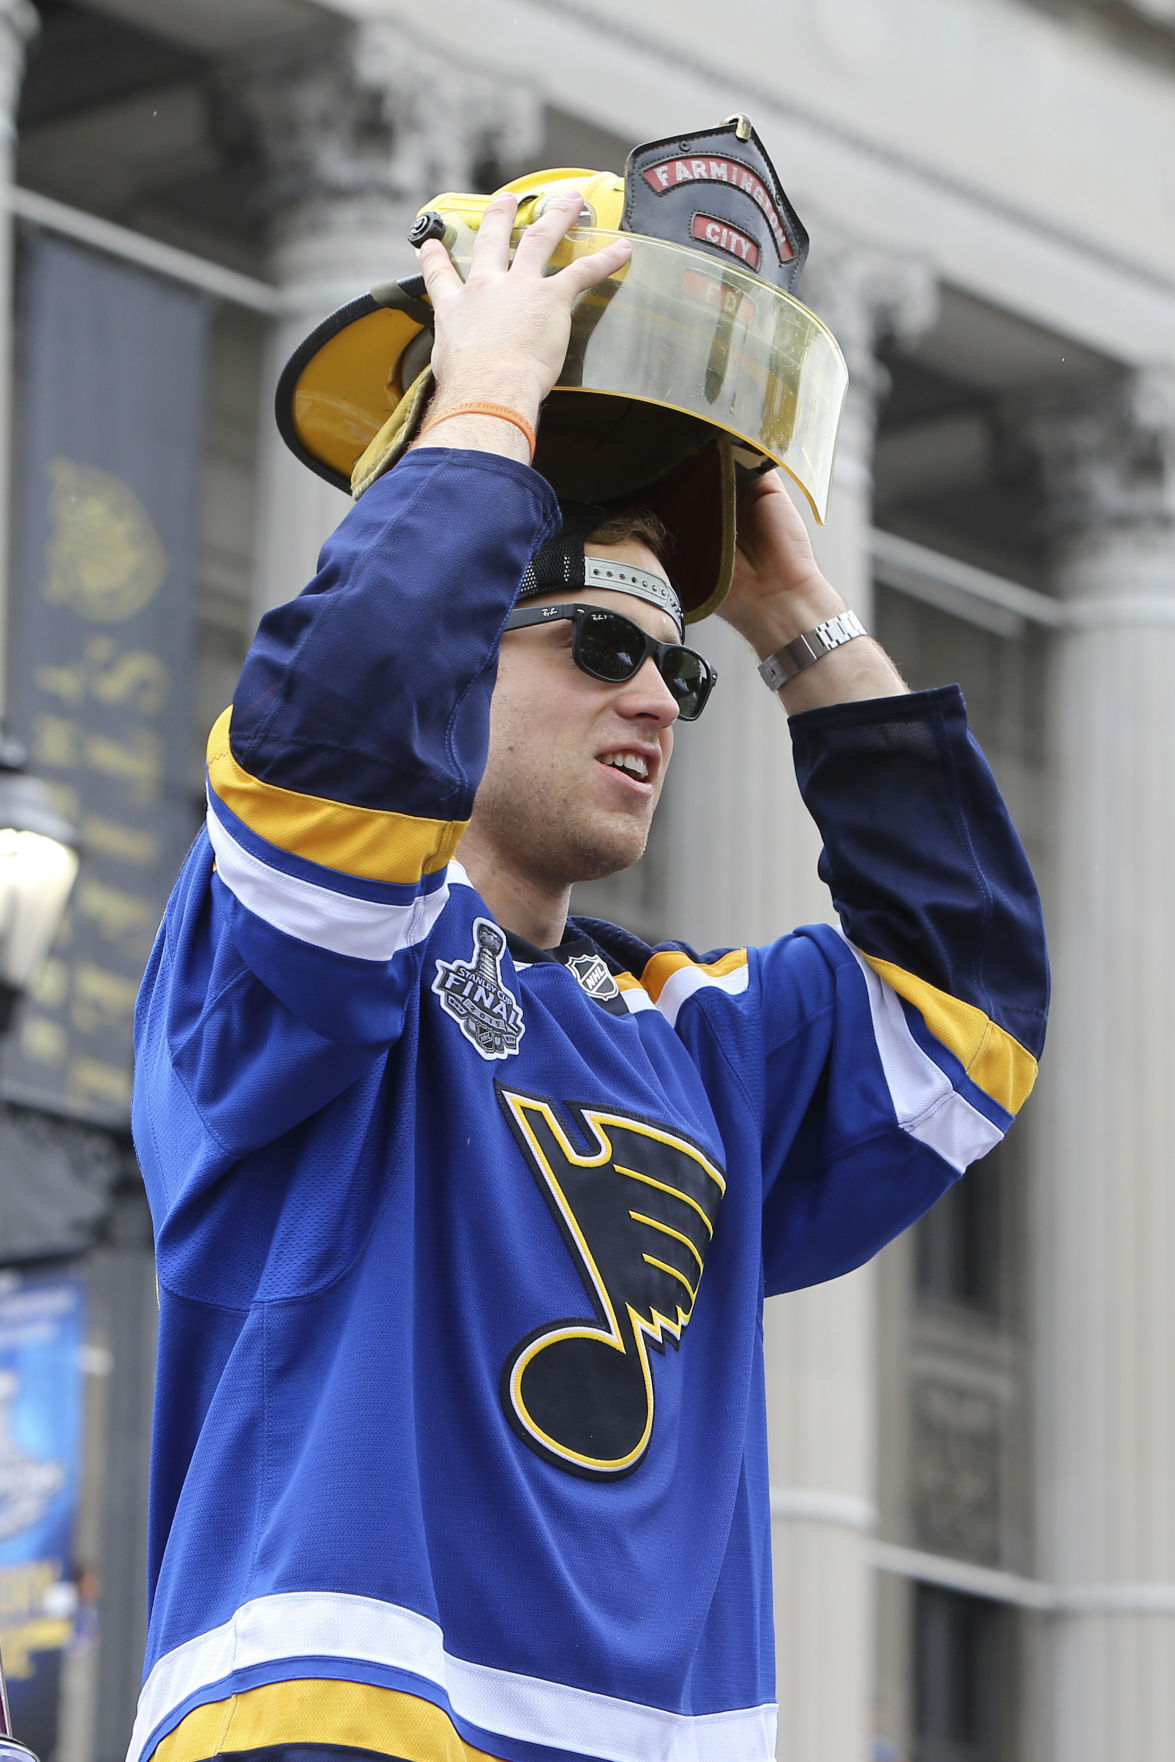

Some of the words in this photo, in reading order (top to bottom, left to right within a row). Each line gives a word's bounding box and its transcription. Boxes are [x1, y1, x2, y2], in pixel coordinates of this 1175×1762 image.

[653, 160, 786, 242] FARMINGTON
[705, 223, 751, 259] CITY
[458, 967, 497, 993] STANLEY
[496, 990, 513, 1005] CUP
[586, 962, 606, 989] NHL
[445, 972, 519, 1031] FINAL
